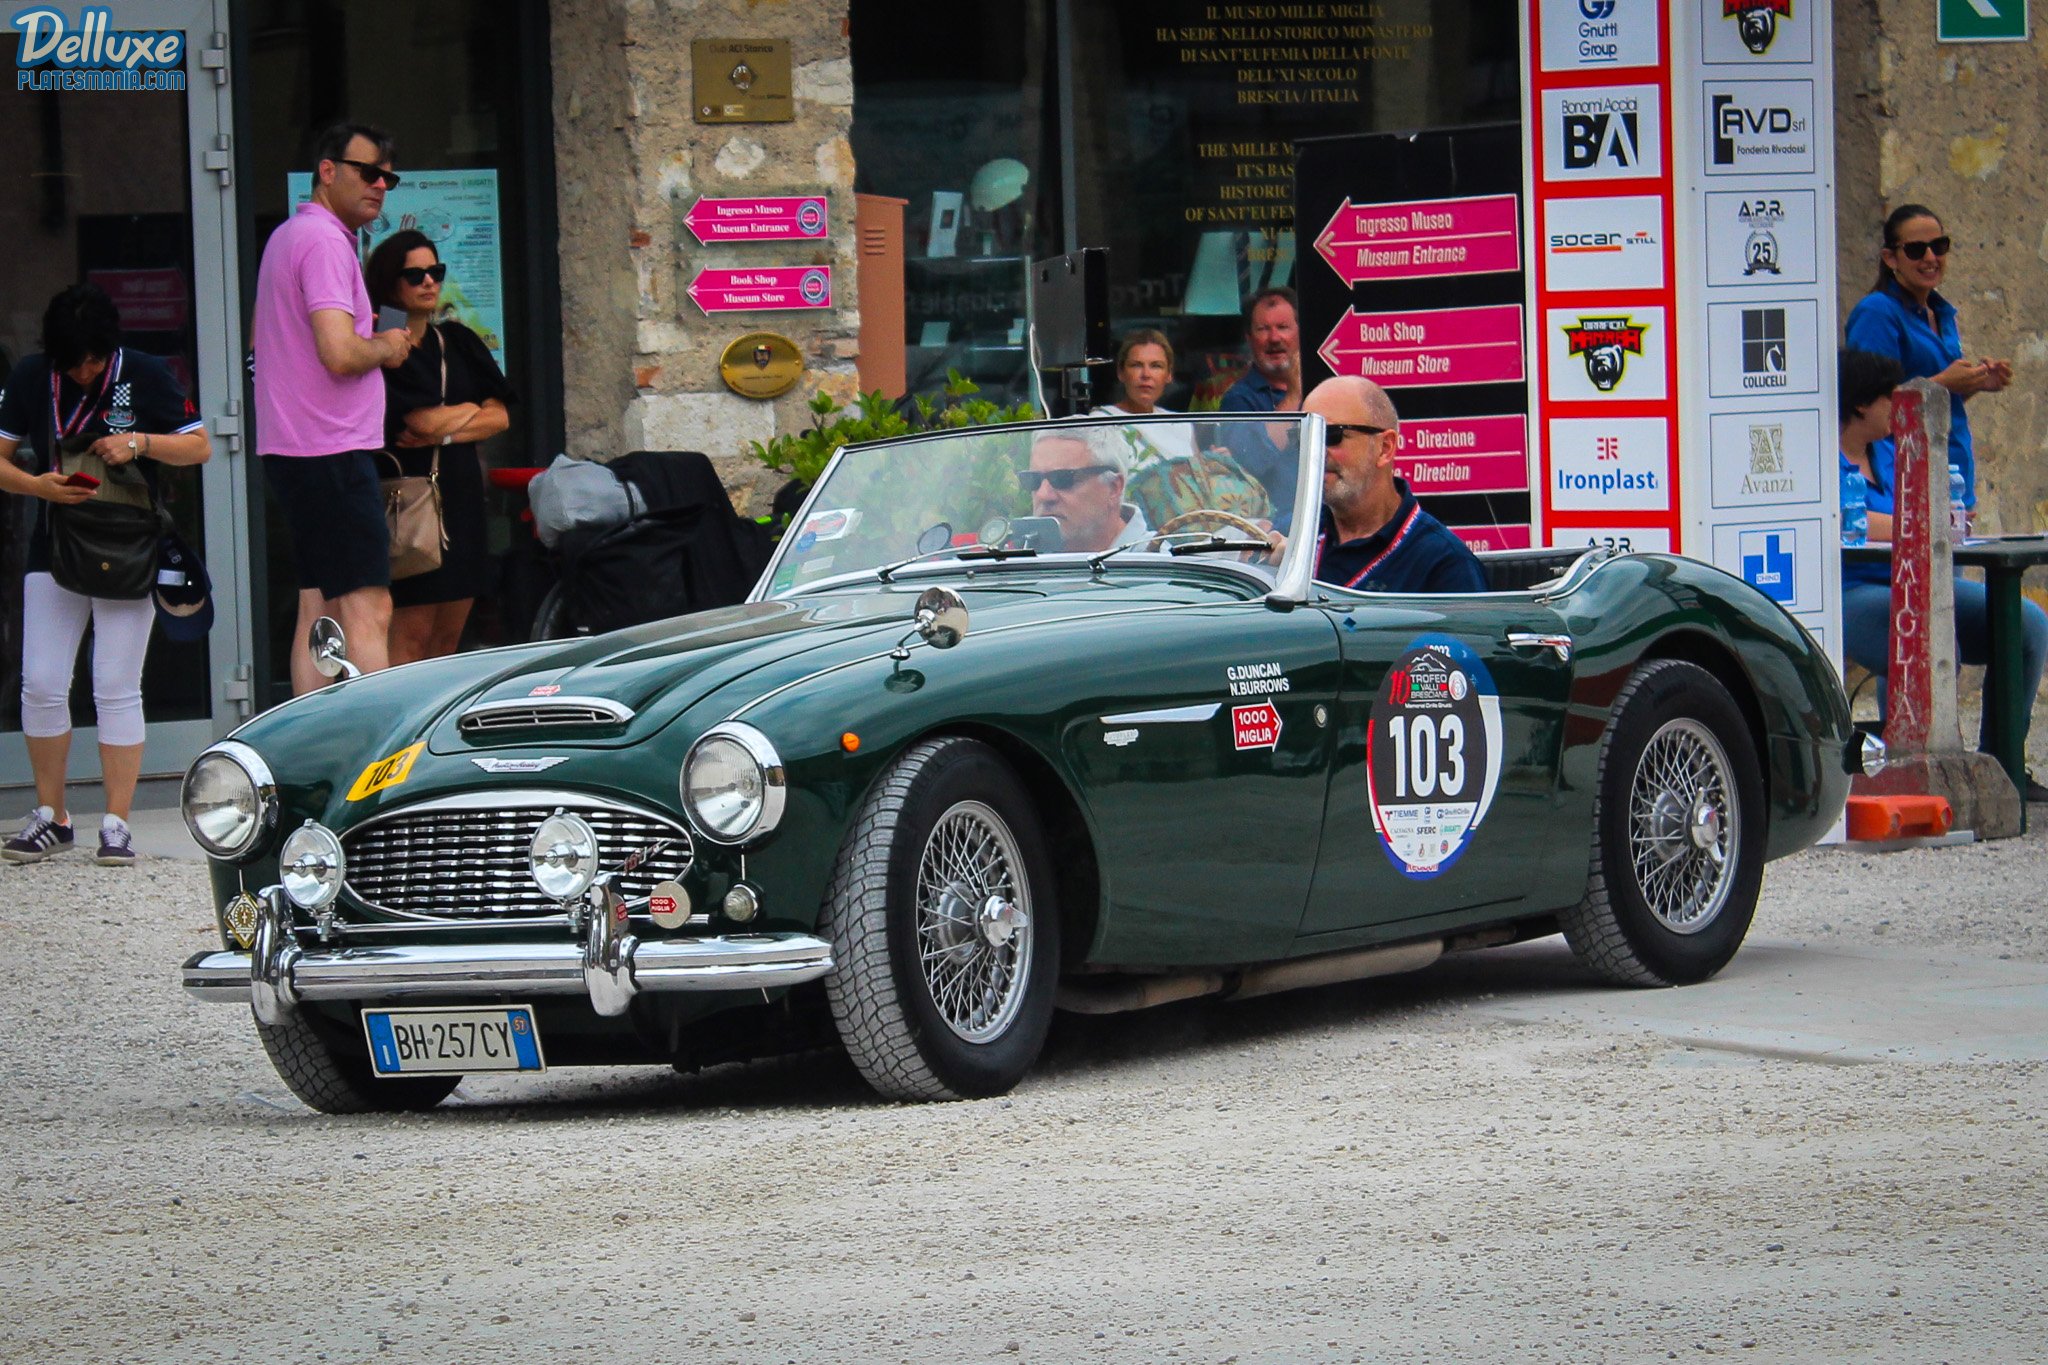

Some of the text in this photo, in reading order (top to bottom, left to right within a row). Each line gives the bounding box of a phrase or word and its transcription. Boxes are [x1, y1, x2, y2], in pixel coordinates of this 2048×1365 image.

[1207, 4, 1385, 20] IL MUSEO MILLE MIGLIA
[1157, 24, 1433, 42] HA SEDE NELLO STORICO MONASTERO
[1181, 46, 1410, 62] DI SANT'EUFEMIA DELLA FONTE
[1578, 41, 1618, 57] Group
[1237, 67, 1358, 83] DELL'XI SECOLO
[1237, 89, 1302, 104] BRESCIA
[1310, 89, 1360, 103] ITALIA
[1562, 99, 1602, 114] Bonomi
[1199, 143, 1228, 158] THE
[1231, 142, 1279, 157] MILLE
[1236, 163, 1265, 178] IT'S
[1220, 184, 1291, 200] HISTORIC
[716, 204, 783, 217] Ingresso Museo
[1185, 207, 1205, 222] OF
[711, 223, 790, 234] Museum Entrance
[1355, 211, 1453, 237] Ingresso Museo
[1550, 233, 1622, 246] socar
[1356, 245, 1467, 267] Museum Entrance
[1753, 242, 1771, 264] 25
[730, 275, 777, 286] Book Shop
[723, 292, 786, 304] Museum Store
[1359, 321, 1425, 344] Book Shop
[1361, 354, 1450, 376] Museum Store
[1742, 375, 1787, 389] COLLICELLI
[1416, 428, 1476, 449] Direzione
[1413, 461, 1471, 482] Direction
[1558, 467, 1656, 495] Ironplast
[1740, 470, 1794, 495] Avanzi
[1226, 662, 1282, 681] G.DUNCAN
[1410, 673, 1448, 683] TROFEO
[1229, 678, 1290, 697] N.BURROWS
[1411, 690, 1448, 698] BRESCIANE
[1420, 683, 1439, 691] VALLI
[1237, 709, 1269, 725] 1000
[1237, 727, 1273, 745] MIGLIA
[1388, 713, 1465, 798] 103
[364, 750, 411, 792] 103
